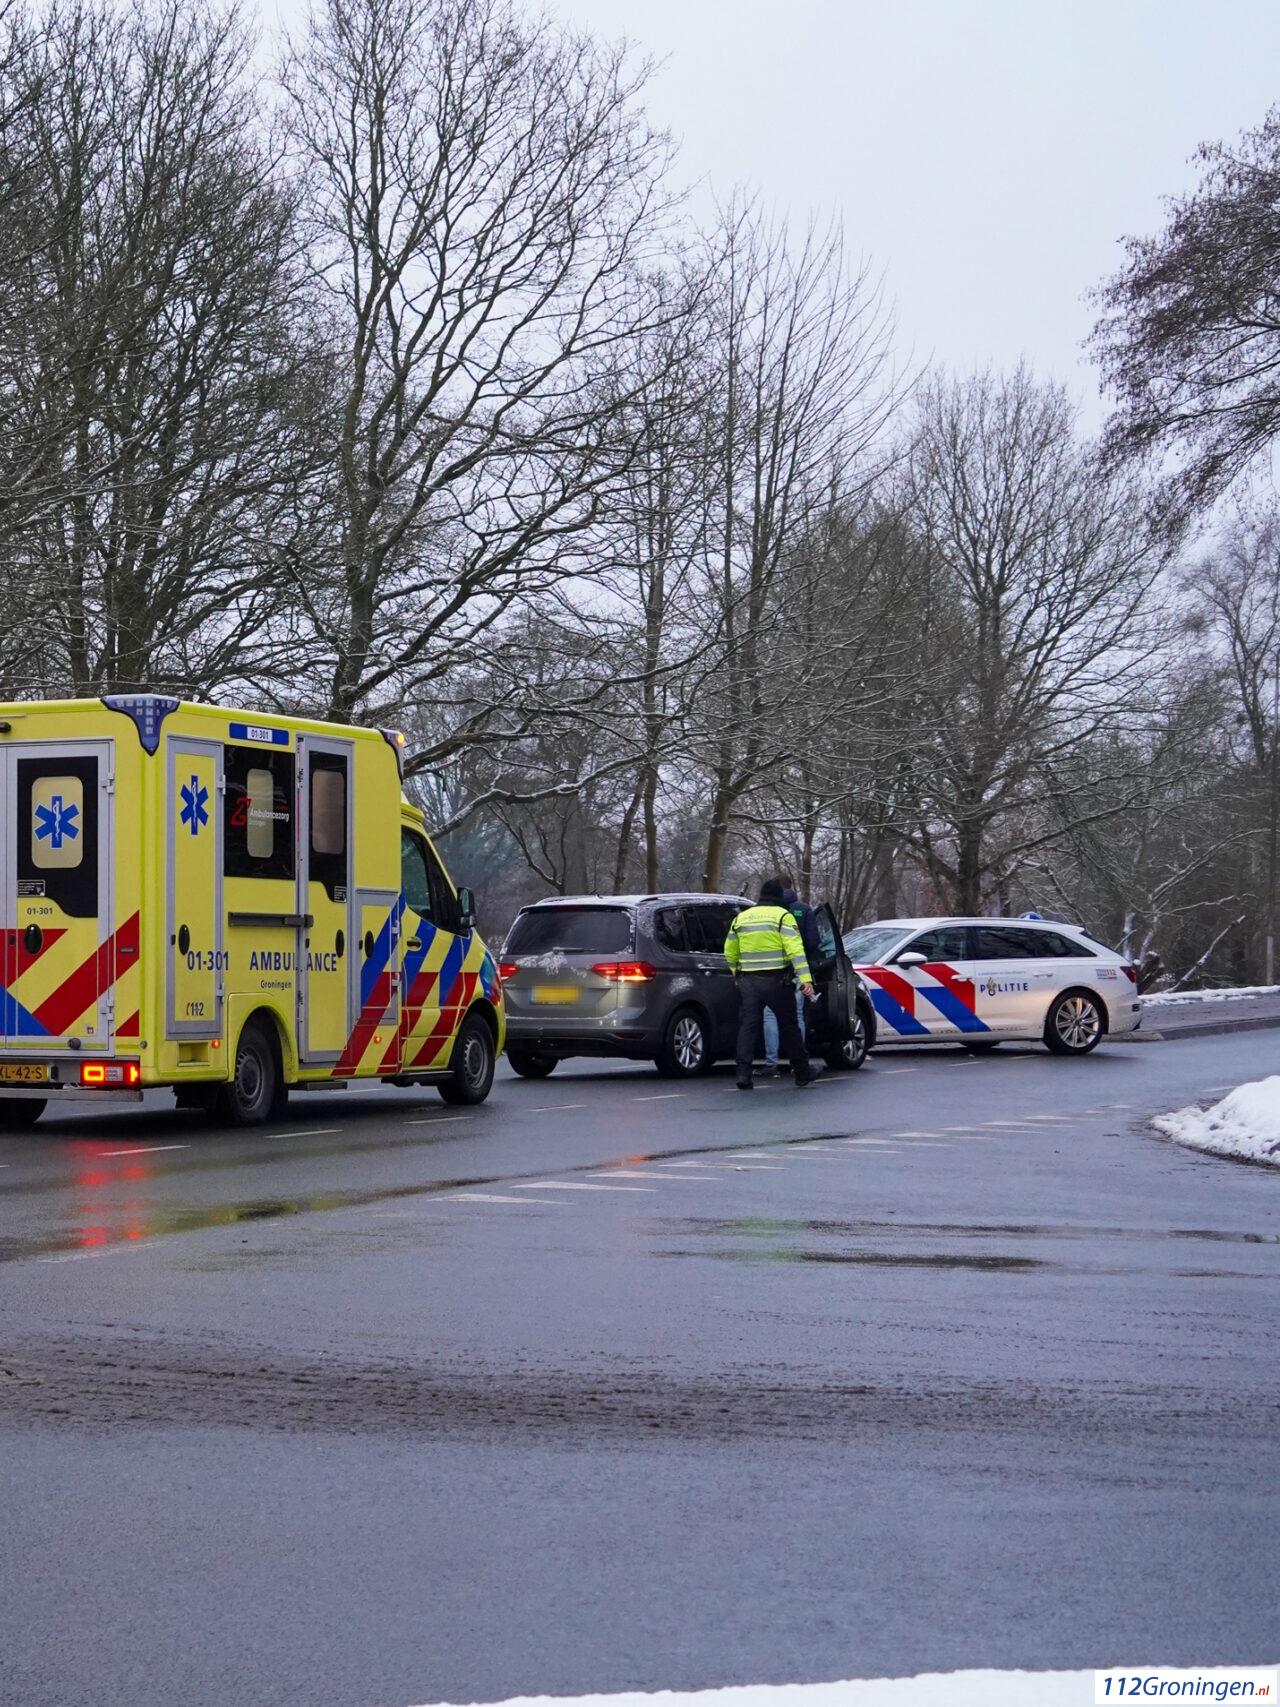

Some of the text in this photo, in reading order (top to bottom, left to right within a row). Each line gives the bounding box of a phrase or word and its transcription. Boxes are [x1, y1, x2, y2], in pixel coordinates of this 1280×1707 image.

[251, 729, 269, 739] 01-301
[250, 808, 290, 822] Ambulancezorg
[26, 907, 53, 915] 01-301
[187, 950, 229, 971] 01-301
[260, 979, 292, 991] Groningen
[980, 981, 1029, 996] POLITIE
